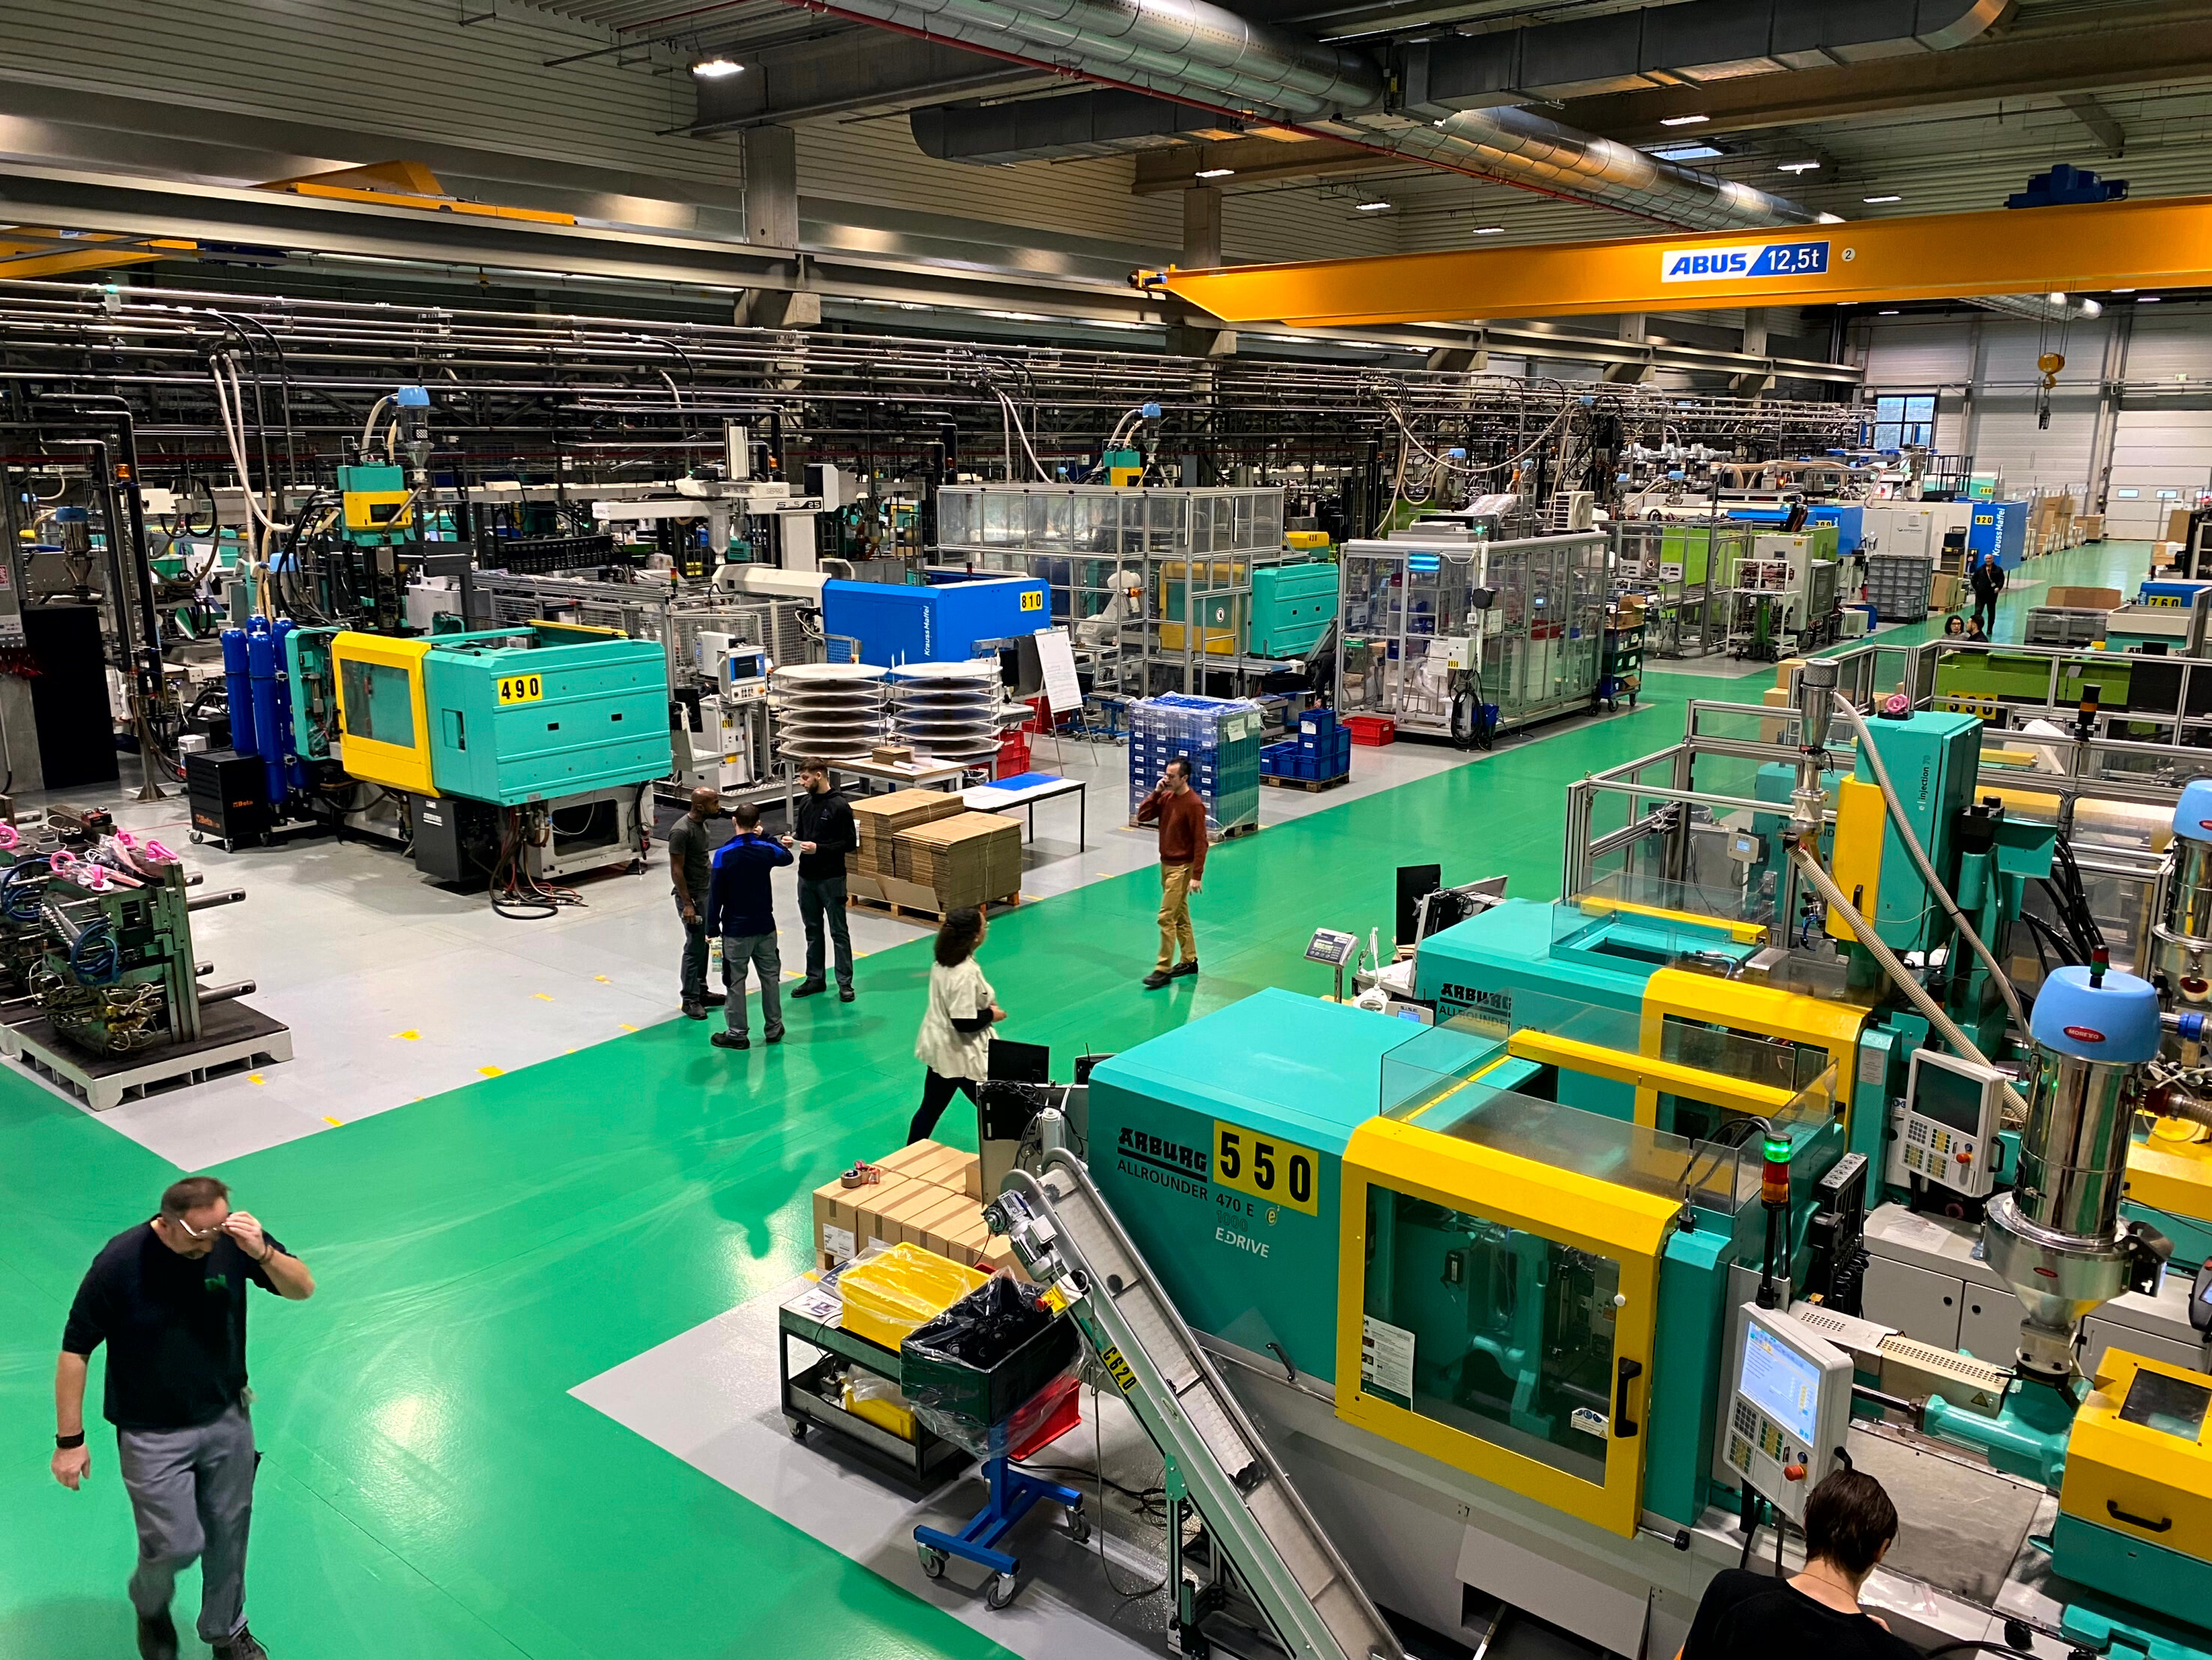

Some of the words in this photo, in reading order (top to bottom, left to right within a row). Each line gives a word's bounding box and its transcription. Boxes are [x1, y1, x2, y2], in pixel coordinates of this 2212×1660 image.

[1669, 253, 1747, 276] ABUS
[1767, 247, 1819, 273] 12,5t
[1845, 250, 1851, 259] 2
[1976, 516, 1992, 524] 920
[1022, 593, 1041, 609] 810
[2151, 598, 2179, 607] 760
[501, 677, 539, 700] 490
[1917, 766, 1929, 800] injection
[1441, 982, 1512, 1010] ARBURG
[1439, 1005, 1510, 1030] ALLROUNDER
[1118, 1127, 1208, 1173] ARBURG
[1117, 1159, 1208, 1201] ALLROUNDER
[1220, 1131, 1311, 1203] 550
[1216, 1193, 1241, 1212] 470
[1247, 1203, 1254, 1218] E
[1103, 1347, 1137, 1390] C620
